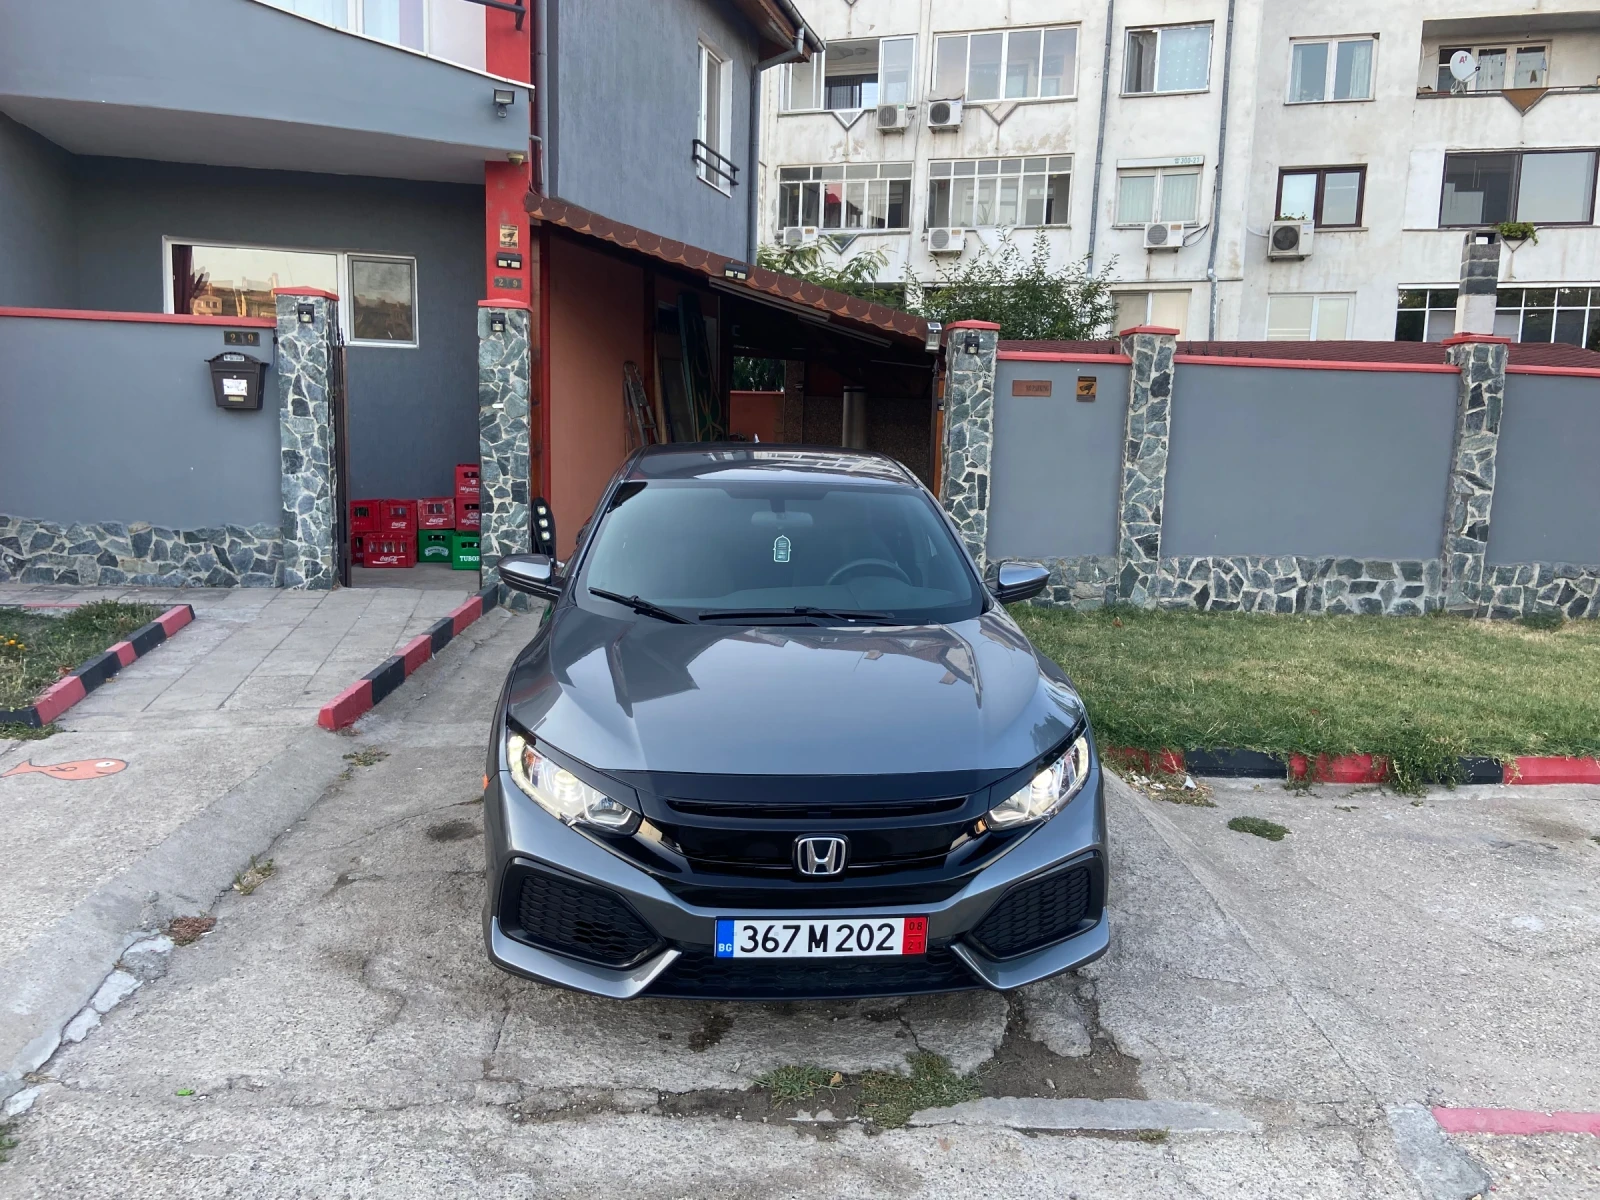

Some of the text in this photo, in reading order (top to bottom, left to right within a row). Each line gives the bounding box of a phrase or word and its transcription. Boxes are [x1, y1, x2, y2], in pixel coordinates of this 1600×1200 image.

[908, 921, 923, 931] 08
[718, 943, 733, 952] BG
[907, 941, 922, 950] 21
